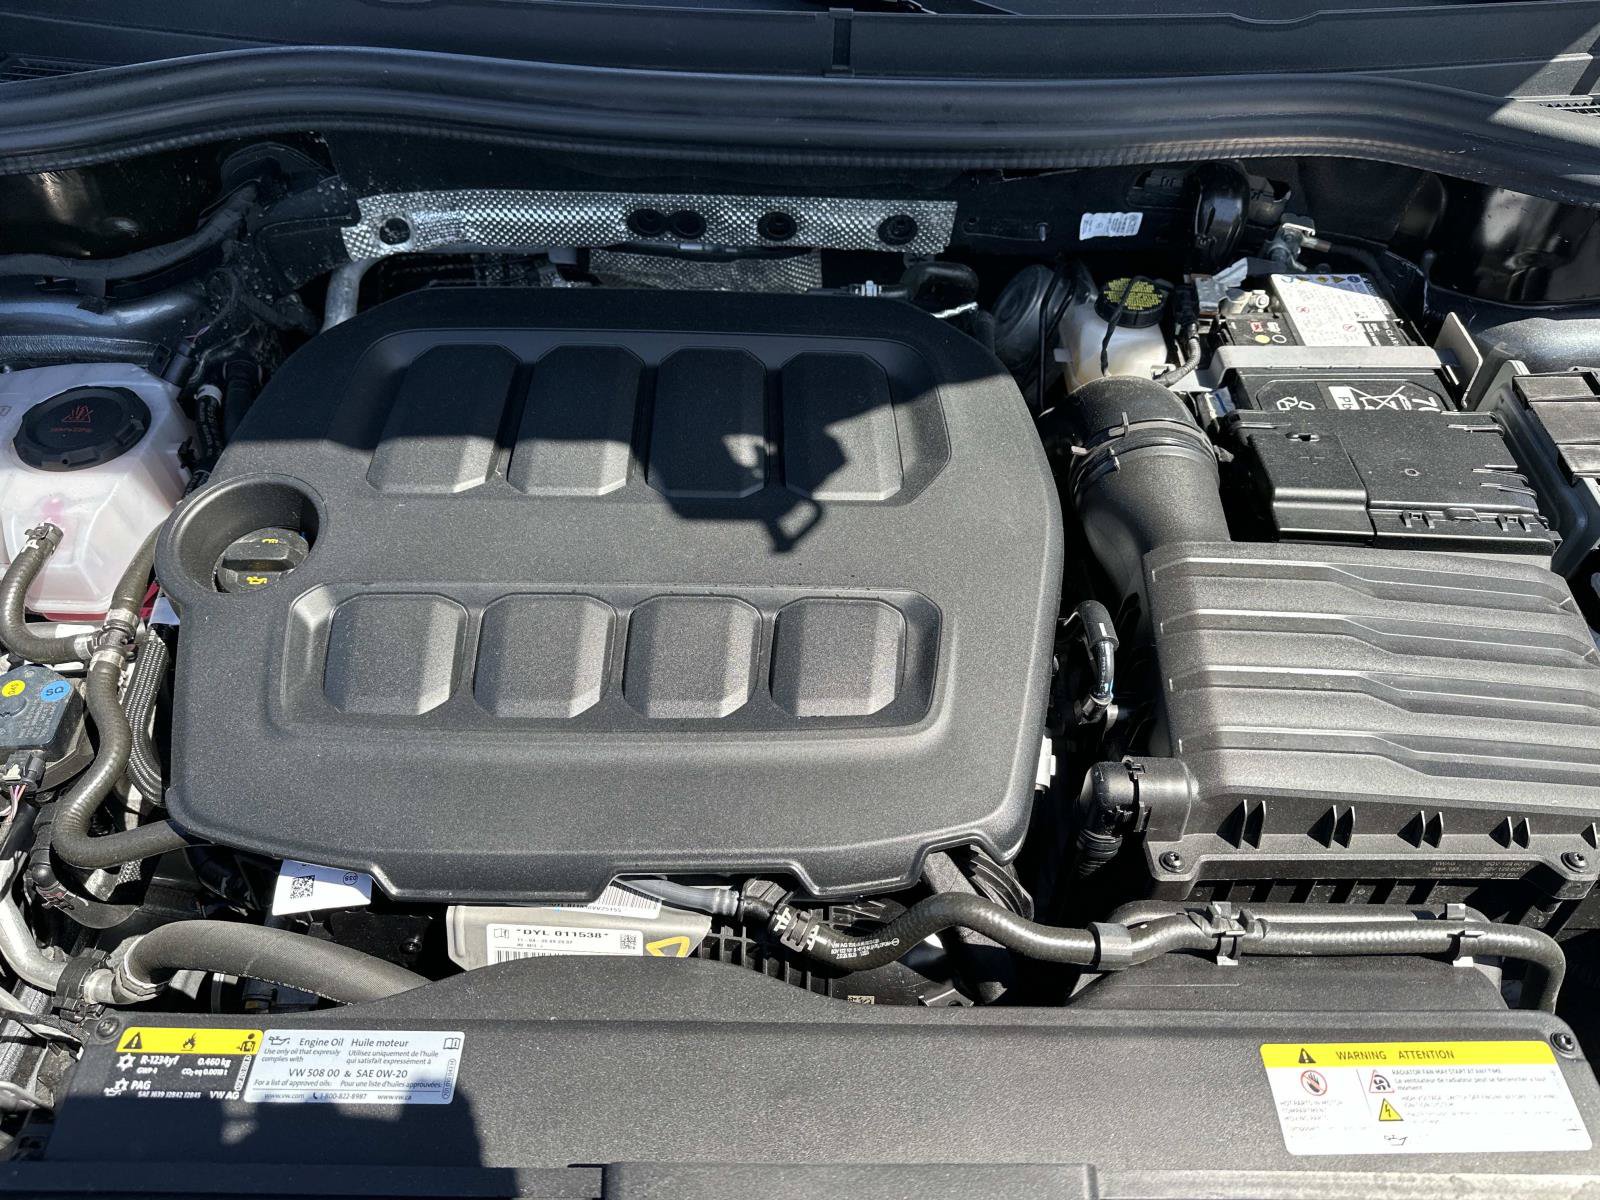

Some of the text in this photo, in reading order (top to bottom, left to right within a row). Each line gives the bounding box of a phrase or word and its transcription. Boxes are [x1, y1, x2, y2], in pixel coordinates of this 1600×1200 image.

[46, 686, 64, 696] SQ
[299, 1038, 344, 1048] Engine Oil
[351, 1038, 409, 1047] Huile moteur
[276, 1048, 289, 1056] only
[1336, 1050, 1455, 1061] WARNING ATTENTION
[140, 1055, 180, 1067] R-1234yf
[220, 1058, 231, 1068] kg
[289, 1068, 305, 1077] VW
[306, 1068, 325, 1077] 508
[327, 1068, 340, 1077] 00
[356, 1069, 374, 1078] SAE
[376, 1069, 408, 1078] 0W-20
[130, 1080, 151, 1090] PAG
[209, 1091, 240, 1099] VW AG
